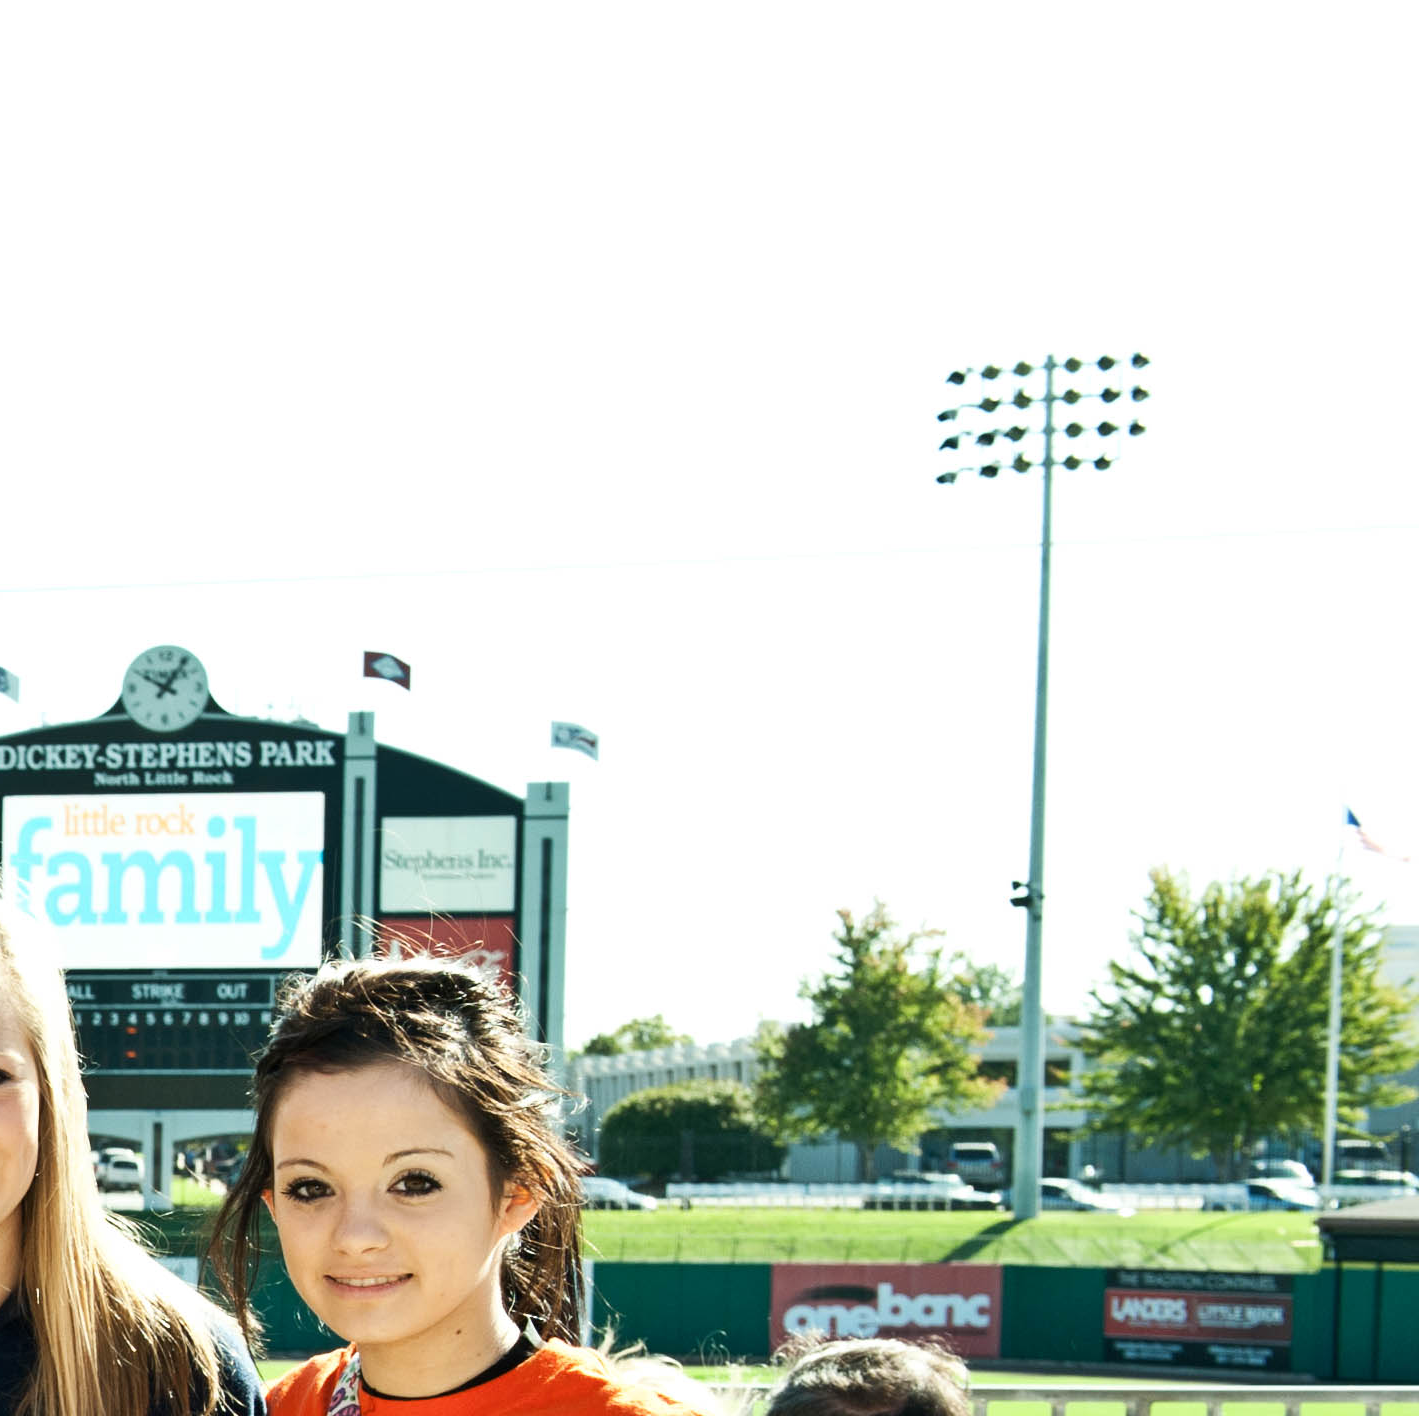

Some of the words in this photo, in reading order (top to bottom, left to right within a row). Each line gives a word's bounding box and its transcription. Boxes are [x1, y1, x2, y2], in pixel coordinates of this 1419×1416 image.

[260, 741, 336, 766] PARK
[94, 772, 139, 786] North
[144, 772, 189, 786] Little
[193, 771, 233, 785] Rock
[64, 804, 125, 837] little
[135, 804, 196, 837] rock
[384, 849, 475, 873] Stephens
[10, 815, 324, 960] family
[67, 984, 95, 1000] ALL
[131, 983, 185, 1000] STRIKE
[216, 983, 249, 999] OUT
[128, 1012, 138, 1026] 4
[146, 1012, 156, 1026] 5
[163, 1012, 174, 1026] 6
[182, 1012, 192, 1026] 7
[199, 1012, 209, 1026] 8
[218, 1012, 229, 1026] 9
[234, 1012, 250, 1026] 10
[783, 1283, 991, 1338] onebanc
[1111, 1296, 1188, 1325] LANDERS
